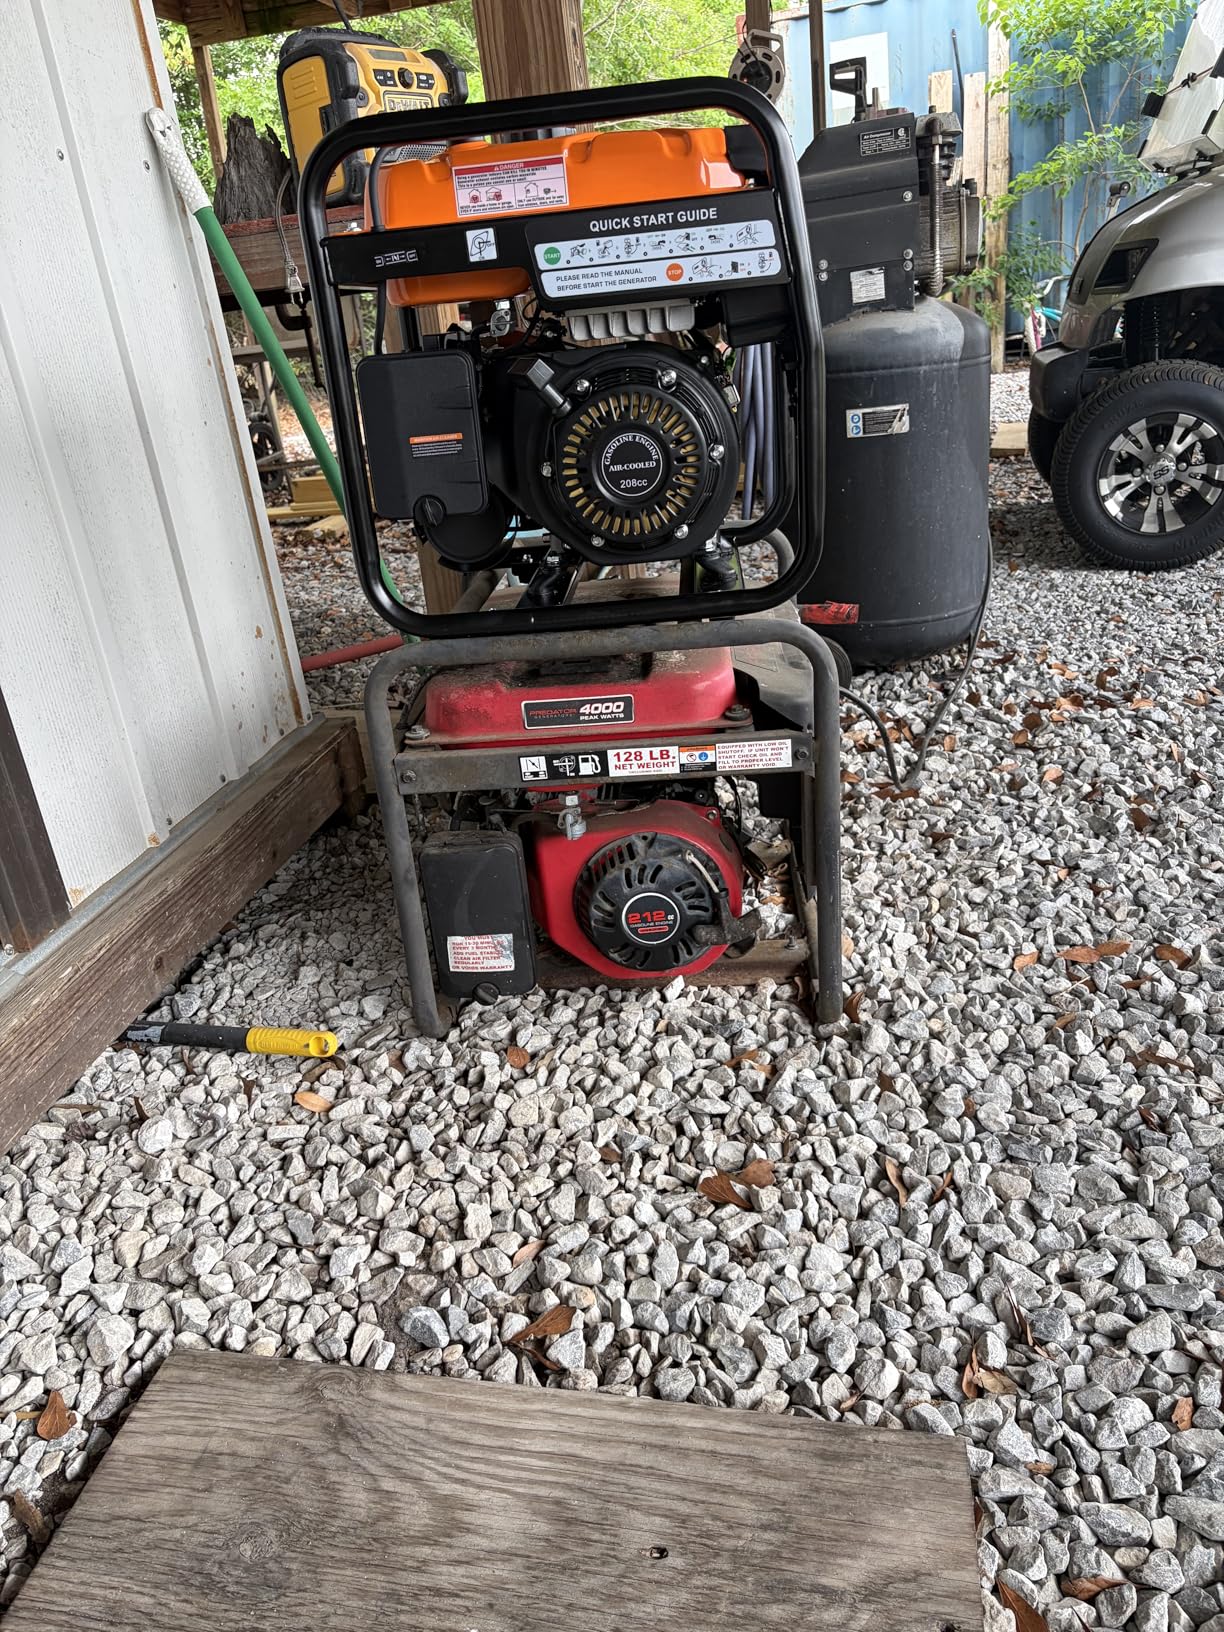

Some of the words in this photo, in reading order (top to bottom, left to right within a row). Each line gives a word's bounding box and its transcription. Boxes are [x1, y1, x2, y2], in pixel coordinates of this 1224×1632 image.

[500, 162, 524, 170] DANGER
[590, 217, 631, 232] QUICK
[633, 212, 674, 227] START
[677, 208, 718, 222] GUIDE
[618, 276, 656, 285] GENERATOR
[604, 436, 634, 464] GASOLINE
[636, 436, 658, 460] ENGINE
[608, 460, 656, 472] AIR-COOLED
[1154, 466, 1169, 480] SS
[620, 479, 647, 488] 208cc
[580, 702, 624, 714] 4000
[614, 750, 643, 762] 128
[649, 749, 676, 760] LB.
[637, 761, 676, 769] WEIGHT
[628, 911, 666, 923] 212
